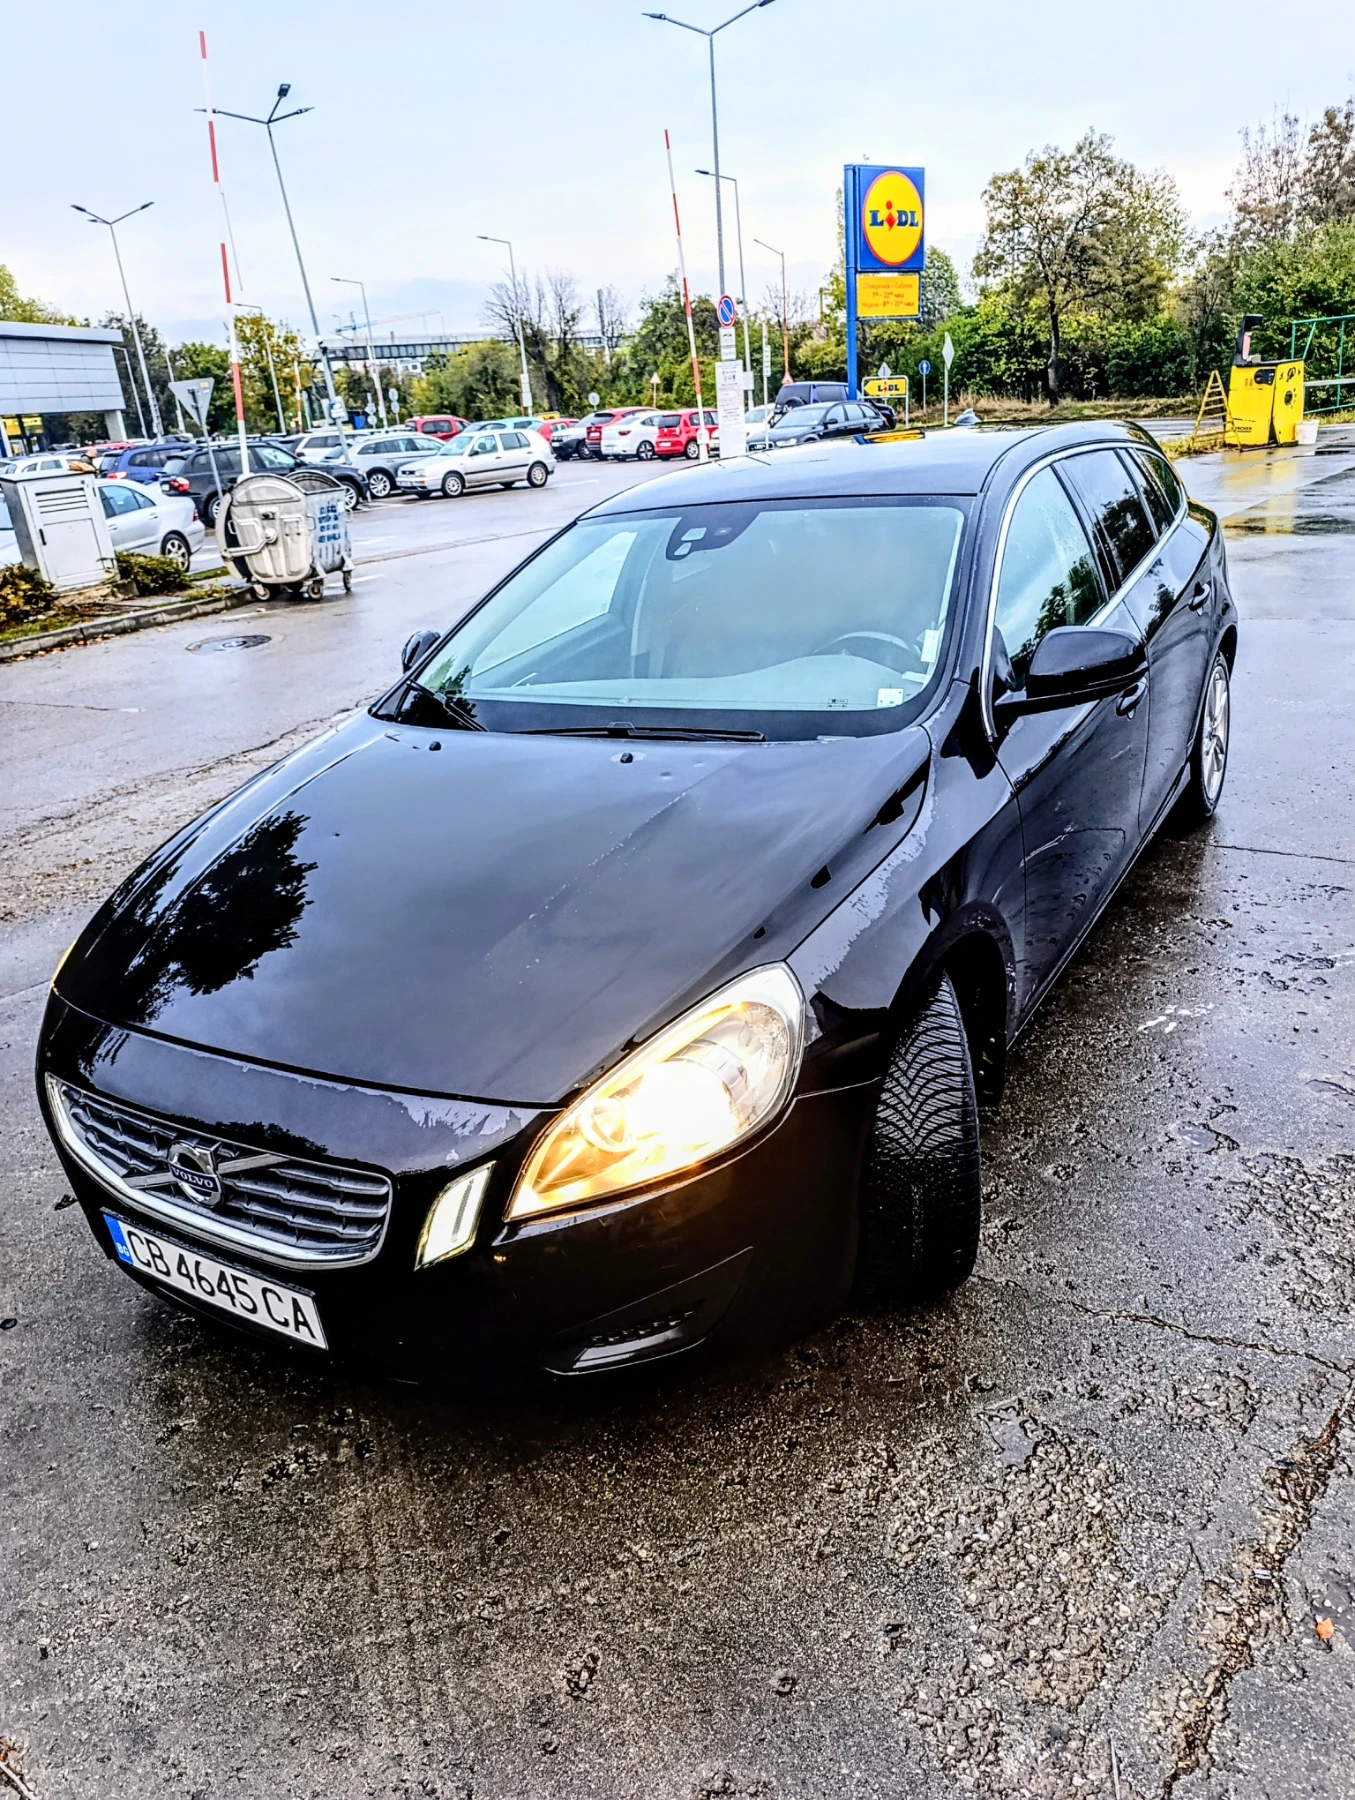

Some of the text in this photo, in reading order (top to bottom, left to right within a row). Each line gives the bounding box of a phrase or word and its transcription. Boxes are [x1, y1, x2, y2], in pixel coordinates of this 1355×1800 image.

[171, 1166, 214, 1188] VOLVO
[116, 1242, 130, 1257] BG
[127, 1230, 317, 1340] CB 4645 CA
